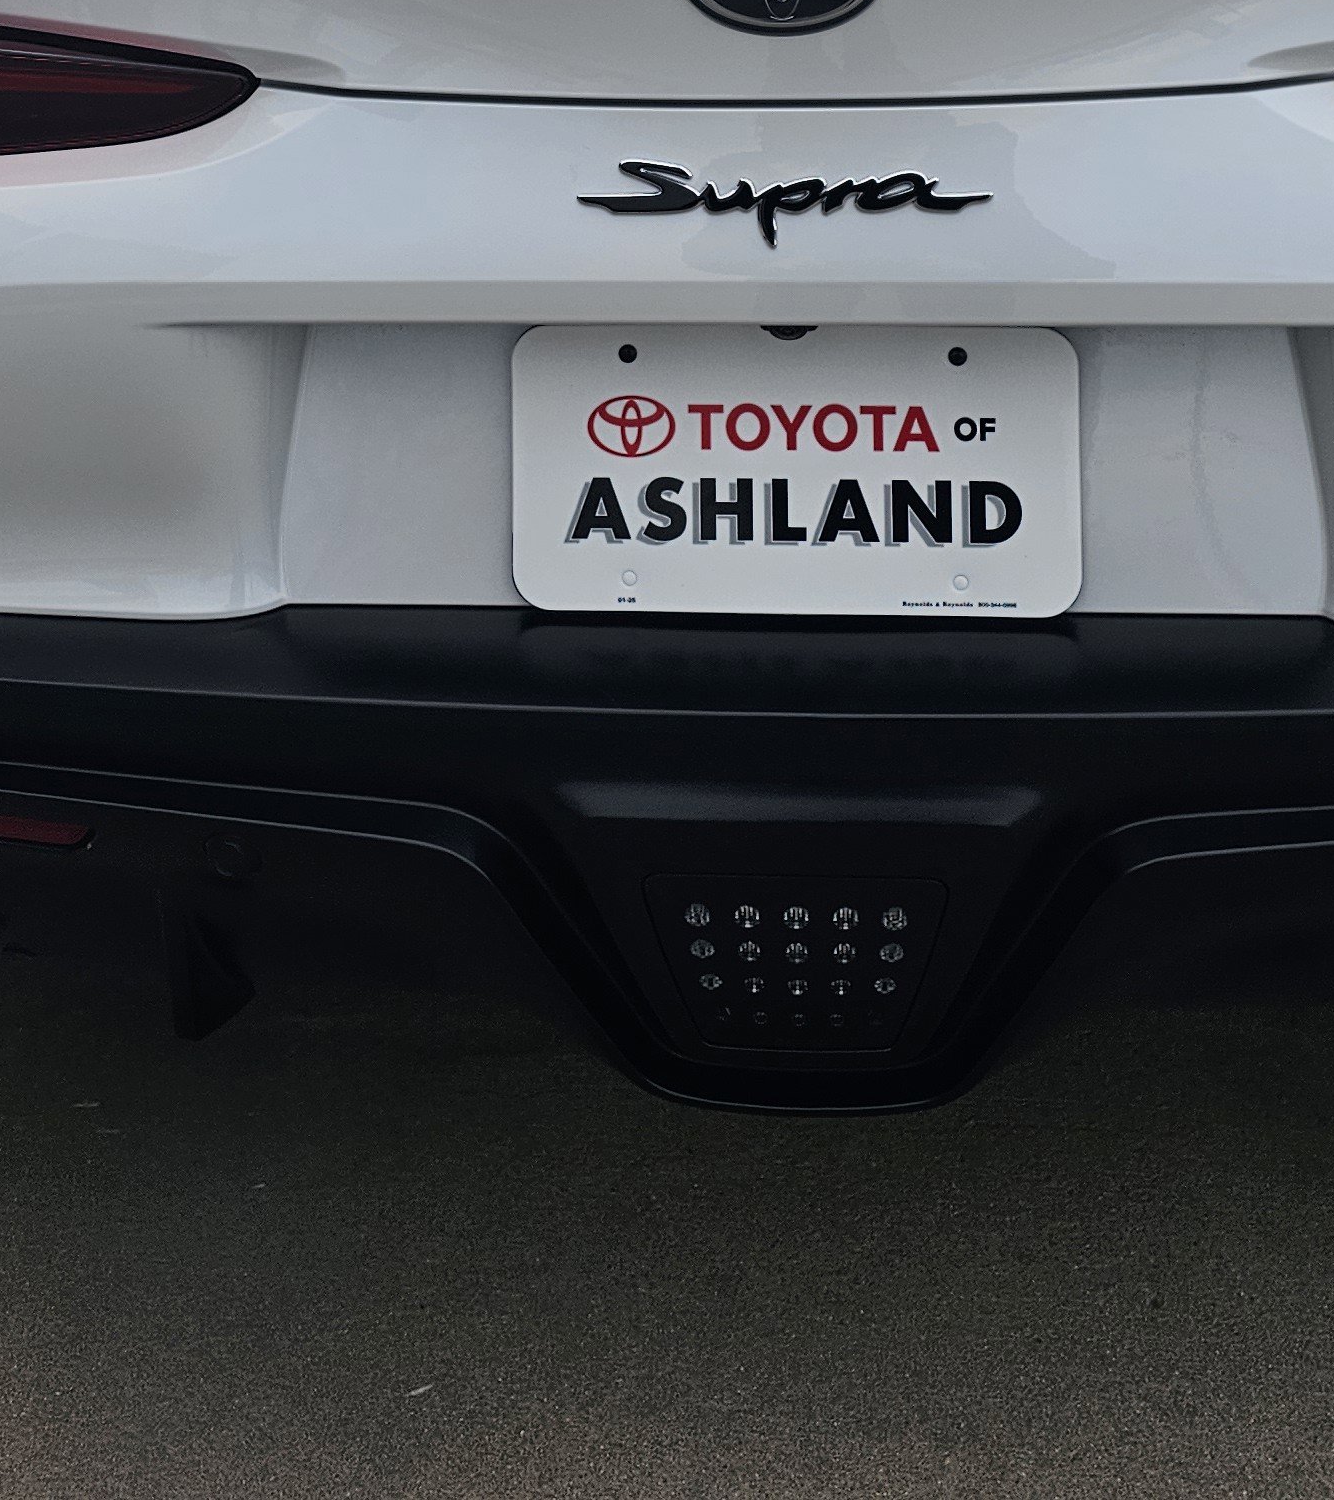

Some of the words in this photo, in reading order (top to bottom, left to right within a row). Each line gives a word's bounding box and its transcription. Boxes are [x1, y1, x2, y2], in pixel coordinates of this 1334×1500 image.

[576, 158, 994, 249] Supra
[687, 403, 940, 452] TOYOTA
[954, 417, 996, 442] OF
[566, 476, 1023, 547] ASHLAND
